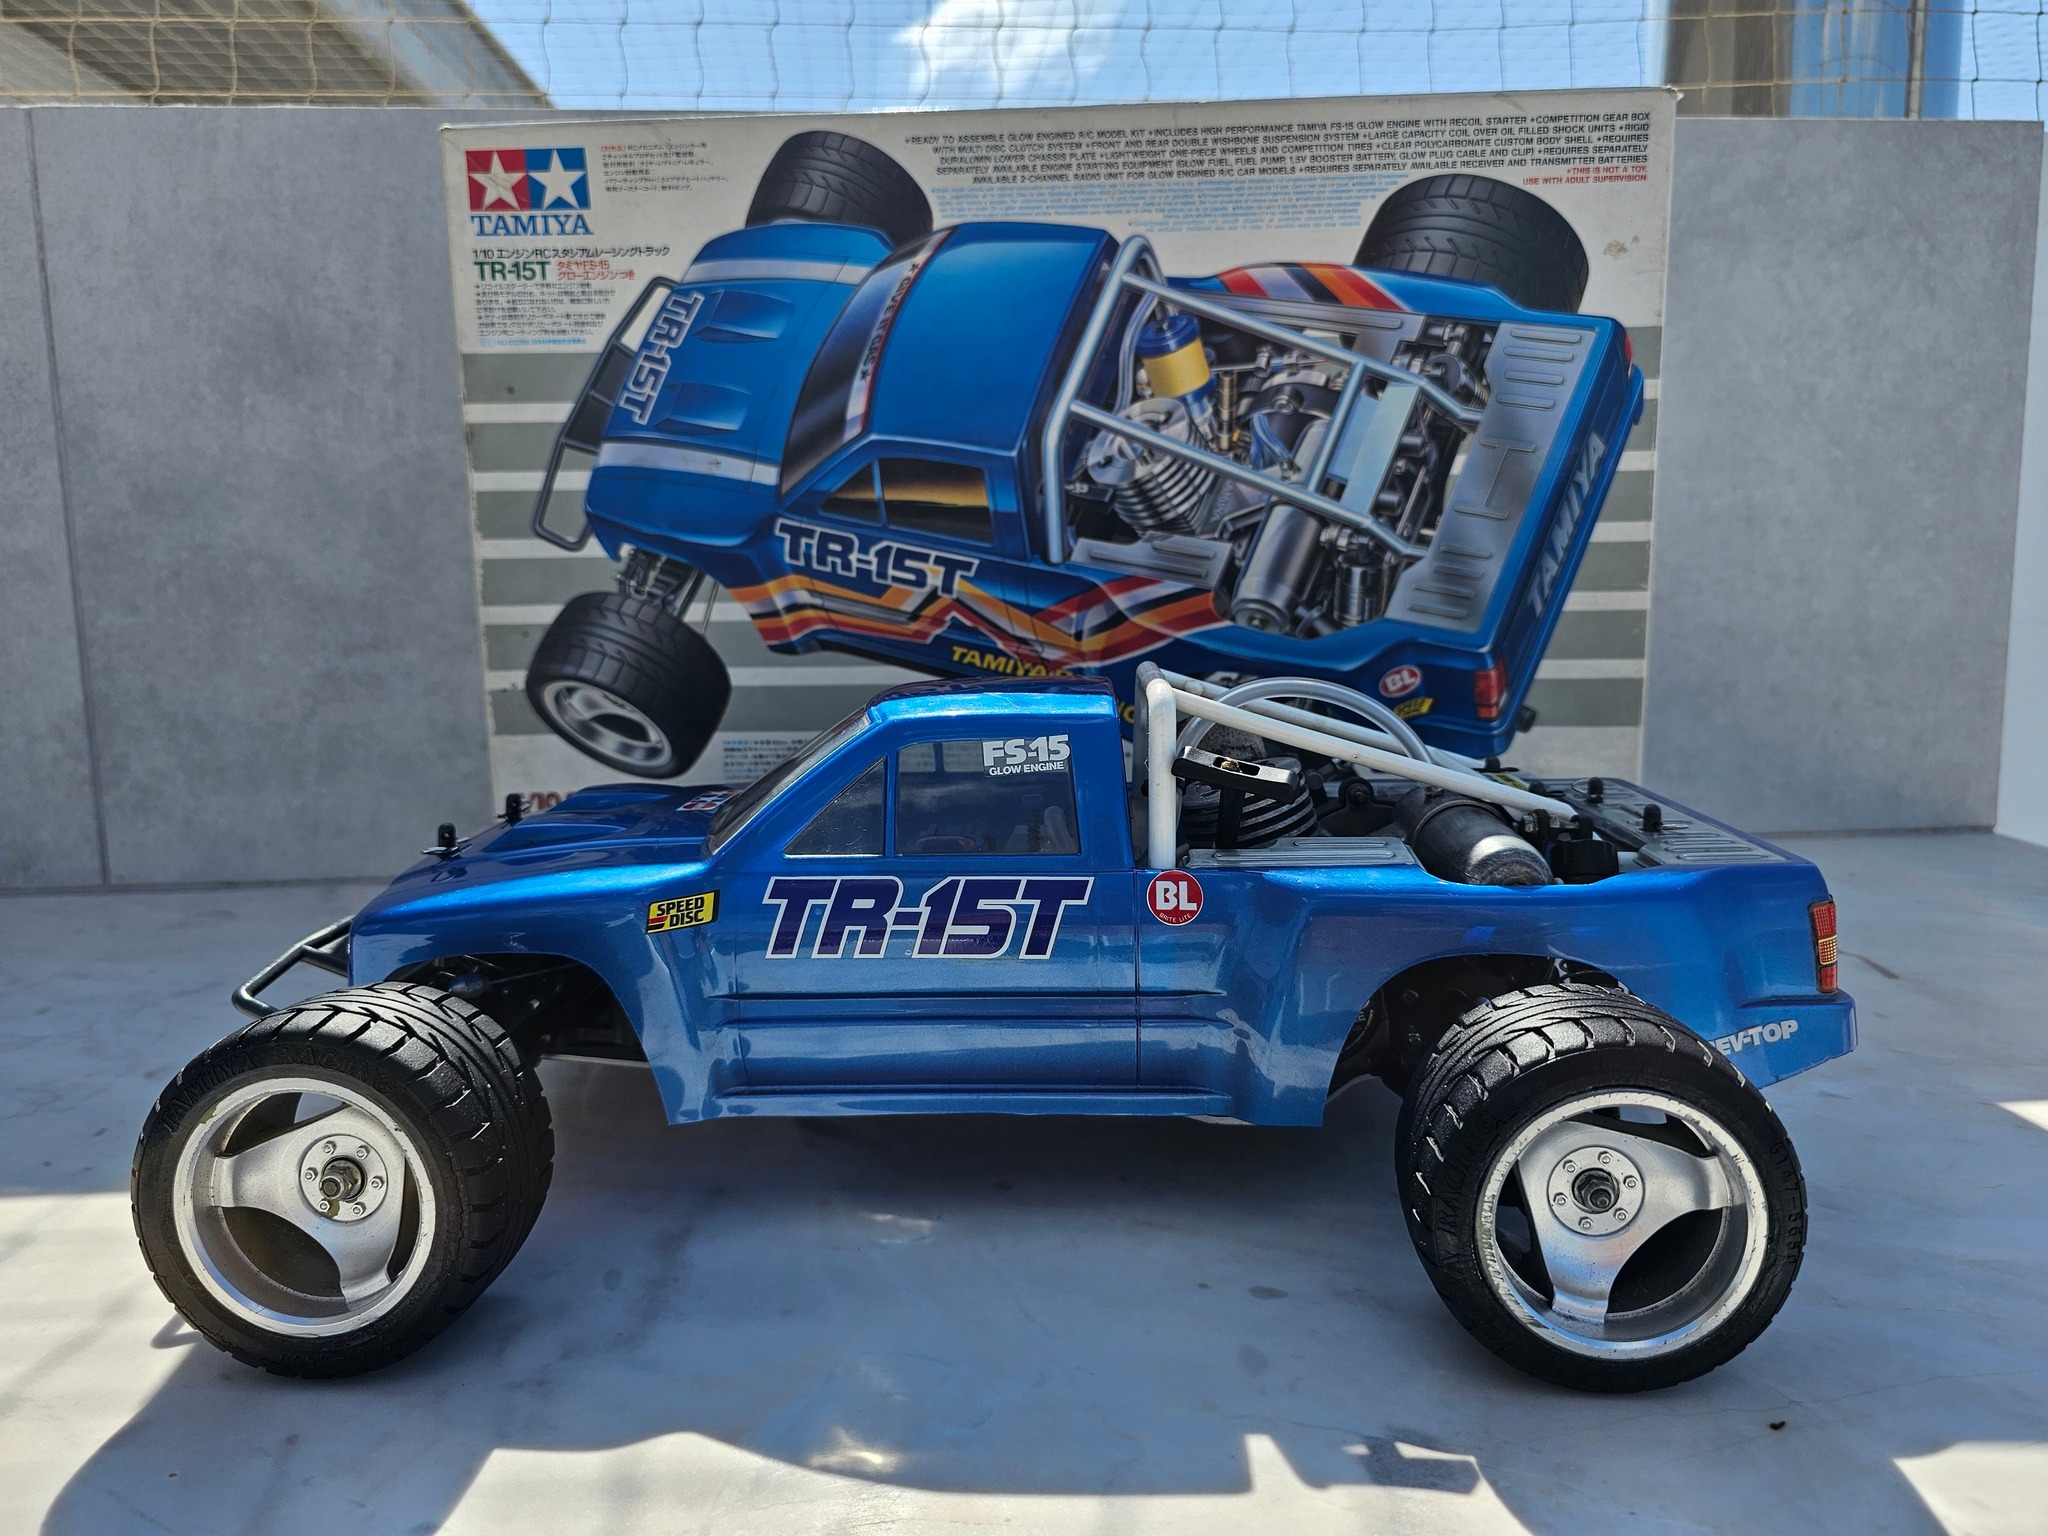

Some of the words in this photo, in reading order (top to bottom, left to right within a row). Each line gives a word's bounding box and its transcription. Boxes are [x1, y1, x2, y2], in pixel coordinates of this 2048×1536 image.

[932, 145, 956, 156] WITH
[957, 144, 983, 155] MULTI
[985, 143, 1006, 154] DISC
[1008, 142, 1045, 154] CLUTCH
[1047, 141, 1083, 152] SYSTEM
[1090, 139, 1121, 151] FRONT
[1124, 139, 1143, 150] AND
[1145, 138, 1170, 149] REAR
[1172, 136, 1208, 148] DOUBLE
[1211, 135, 1260, 147] WISHBONE
[1262, 133, 1320, 145] SUSPENSION
[1323, 131, 1360, 143] SYSTEM
[1368, 130, 1399, 141] LARGE
[1402, 128, 1446, 140] CAPACITY
[1448, 127, 1470, 139] COIL
[1473, 127, 1498, 138] OVER
[1500, 126, 1515, 137] OIL
[1518, 125, 1550, 136] FILLED
[1552, 124, 1585, 135] SHOCK
[1588, 123, 1616, 134] UNITS
[1624, 121, 1650, 133] RIGID
[942, 134, 955, 145] TO
[957, 132, 1004, 144] ASSEMBLE
[1007, 131, 1034, 143] GLOW
[1036, 130, 1076, 142] ENGINED
[1078, 129, 1094, 140] R/C
[1096, 128, 1127, 140] MODEL
[1130, 128, 1145, 138] KIT
[1153, 126, 1198, 138] INCLUDES
[1200, 125, 1223, 136] HIGH
[1225, 122, 1293, 135] PERFORMANCE
[1297, 121, 1327, 133] TAMIYA
[1330, 120, 1354, 132] FS-15
[1356, 119, 1384, 131] GLOW
[1386, 118, 1420, 130] ENGINE
[1424, 117, 1447, 129] WITH
[1449, 116, 1482, 128] RECOIL
[1486, 115, 1527, 126] STARTER
[1535, 112, 1600, 125] COMPETITION
[1602, 111, 1628, 122] GEAR
[1631, 110, 1651, 121] BOX
[936, 165, 989, 177] SEPARATELY
[992, 163, 1038, 175] AVAILABLE
[1040, 162, 1073, 174] ENGINE
[1076, 160, 1120, 172] STARTING
[1122, 159, 1173, 171] EQUIPMENT
[1235, 156, 1257, 167] FUEL
[1309, 152, 1354, 164] BOOSTER
[1399, 150, 1426, 161] GLOW
[1429, 149, 1454, 160] PLUG
[1456, 148, 1486, 159] CABLE
[1490, 147, 1508, 158] AND
[1511, 146, 1534, 158] CLIP)
[1542, 144, 1589, 156] REQUIRES
[1592, 142, 1648, 155] SEPARATELY
[994, 154, 1026, 164] LOWER
[1028, 152, 1067, 163] CHASSIS
[1069, 151, 1096, 162] PLATE
[1104, 149, 1166, 160] LIGHTWEIGHT
[1169, 147, 1217, 158] ONE-PIECE
[1220, 146, 1257, 156] WHEELS
[1260, 145, 1278, 155] AND
[1281, 143, 1344, 154] COMPETITION
[1348, 142, 1373, 152] TIRES
[1381, 140, 1412, 151] CLEAR
[1414, 138, 1492, 150] POLYCARBONATE
[1494, 136, 1534, 147] CUSTOM
[1536, 135, 1561, 146] BODY
[1564, 134, 1592, 145] SHELL
[1602, 132, 1649, 143] REQUIRES
[972, 175, 1018, 186] AVAILABLE
[1020, 173, 1070, 184] 2-CHANNEL
[1073, 172, 1102, 182] RADIO
[1103, 171, 1124, 181] UNIT
[1126, 171, 1146, 181] FOR
[1147, 170, 1174, 180] GLOW
[1176, 168, 1216, 179] ENGINED
[1218, 167, 1234, 178] R/C
[1237, 167, 1256, 177] CAR
[1258, 165, 1296, 176] MODELS
[1304, 164, 1350, 175] REQUIRES
[1352, 162, 1407, 173] SEPARATELY
[1410, 160, 1458, 171] AVAILABLE
[1460, 158, 1505, 169] RECEIVER
[1508, 158, 1527, 168] AND
[1531, 155, 1595, 167] TRANSMITTER
[1598, 153, 1648, 165] BATTERIES
[1523, 177, 1539, 185] USE
[1541, 176, 1562, 185] WITH
[1565, 175, 1591, 184] ADULT
[1593, 174, 1647, 183] SUPERVISION
[1572, 167, 1590, 175] THIS
[1603, 166, 1619, 174] NOT
[471, 214, 595, 237] TAMIYA
[472, 248, 494, 260] 1/10
[474, 260, 551, 281] TR-15T
[618, 290, 705, 426] TR-15T
[1527, 431, 1606, 619] TAMIYA
[775, 517, 980, 600] TR-15T
[951, 645, 1048, 677] TAMIYA
[1384, 669, 1416, 692] BL
[982, 734, 1071, 767] FS-15
[989, 764, 1021, 776] GLOW
[1023, 761, 1064, 773] ENGINE
[656, 896, 705, 917] SPEED
[1155, 880, 1198, 911] BL
[669, 909, 705, 927] DISC
[762, 875, 1095, 961] TR-15T
[1158, 912, 1177, 923] BRITE
[1178, 912, 1193, 923] LITE
[158, 1050, 255, 1133] TAMIYA
[273, 1046, 395, 1095] RACING
